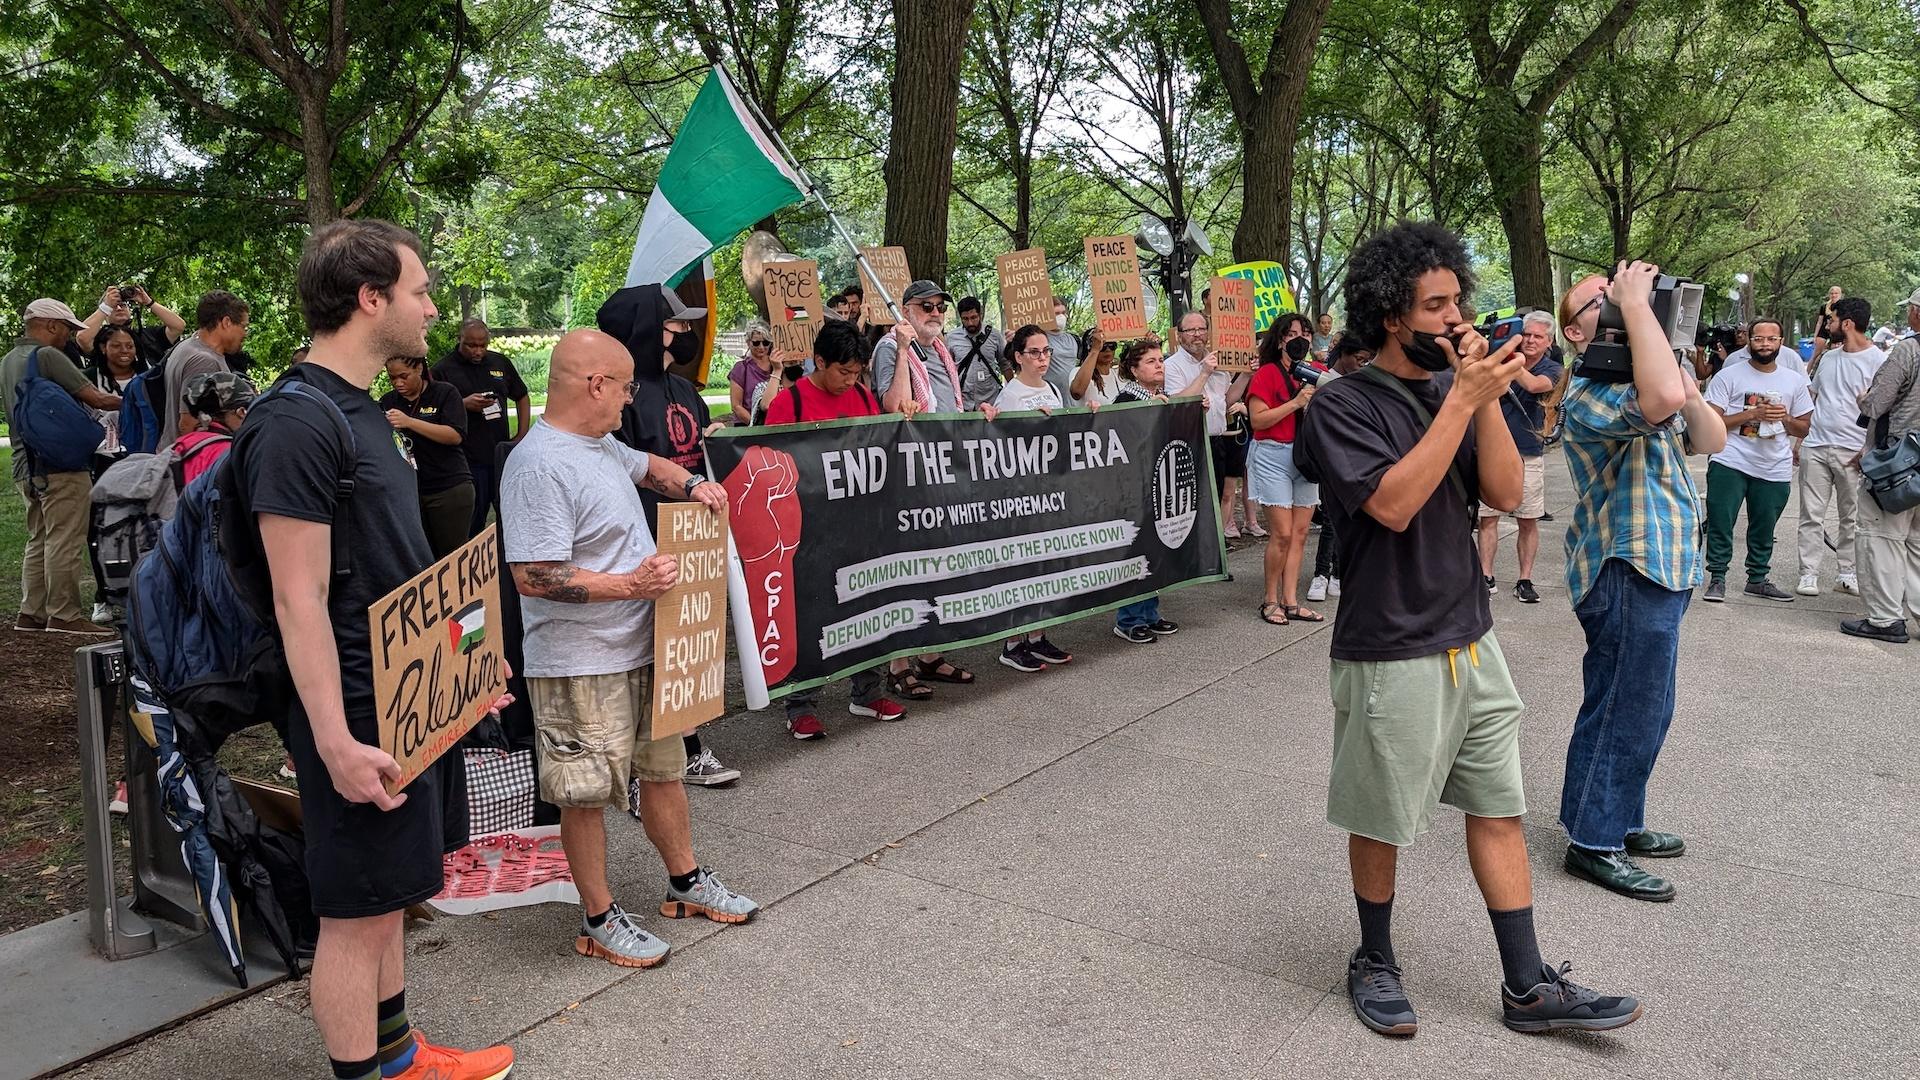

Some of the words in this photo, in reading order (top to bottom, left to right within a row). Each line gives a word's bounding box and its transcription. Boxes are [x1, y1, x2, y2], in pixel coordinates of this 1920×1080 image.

[1093, 242, 1126, 257] PEACE
[1005, 256, 1038, 272] PEACE
[1092, 260, 1133, 277] JUSTICE
[765, 268, 812, 301] FREE
[1003, 269, 1046, 288] JUSTICE
[1105, 279, 1127, 294] AND
[1223, 281, 1242, 295] WE
[1016, 285, 1038, 300] AND
[1273, 289, 1282, 306] A
[1011, 297, 1048, 316] EQUITY
[1101, 297, 1137, 315] EQUITY
[1218, 297, 1235, 312] CAN
[1237, 298, 1249, 312] NO
[1011, 316, 1032, 330] FOR
[1035, 312, 1054, 325] ALL
[1102, 317, 1122, 333] FOR
[1126, 314, 1143, 330] ALL
[1218, 315, 1250, 331] LONGER
[1218, 334, 1251, 349] AFFORD
[1217, 350, 1232, 365] THE
[1234, 352, 1255, 366] RICH
[821, 446, 888, 500] END
[898, 440, 956, 487] THE
[962, 434, 1059, 481] TRUMP
[1069, 428, 1130, 471] ERA
[897, 508, 945, 532] STOP
[947, 501, 988, 527] WHITE
[990, 491, 1066, 520] SUPREMACY
[673, 508, 719, 543] PEACE
[676, 547, 724, 585] USTICE
[848, 555, 943, 592] COMMUNITY
[946, 547, 1000, 572] CONTROL
[1001, 544, 1015, 562] OF
[1016, 539, 1042, 558] THE
[1044, 531, 1089, 554] POLICE
[1089, 525, 1126, 546] NOW!
[941, 597, 980, 620] FREE
[981, 592, 1019, 613] POLICE
[1021, 575, 1080, 601] TORTURE
[1080, 560, 1142, 589] SURVIVORS
[381, 561, 451, 671] FREE
[457, 533, 496, 605] FREE
[679, 590, 711, 627] AND
[760, 570, 783, 667] CPAC
[826, 612, 881, 648] DEFUND
[882, 607, 915, 631] CPD
[665, 627, 720, 676] EQUITY
[385, 637, 501, 760] Palestine
[660, 676, 695, 715] FOR
[698, 663, 721, 704] ALL
[422, 718, 469, 768] EMPIRES
